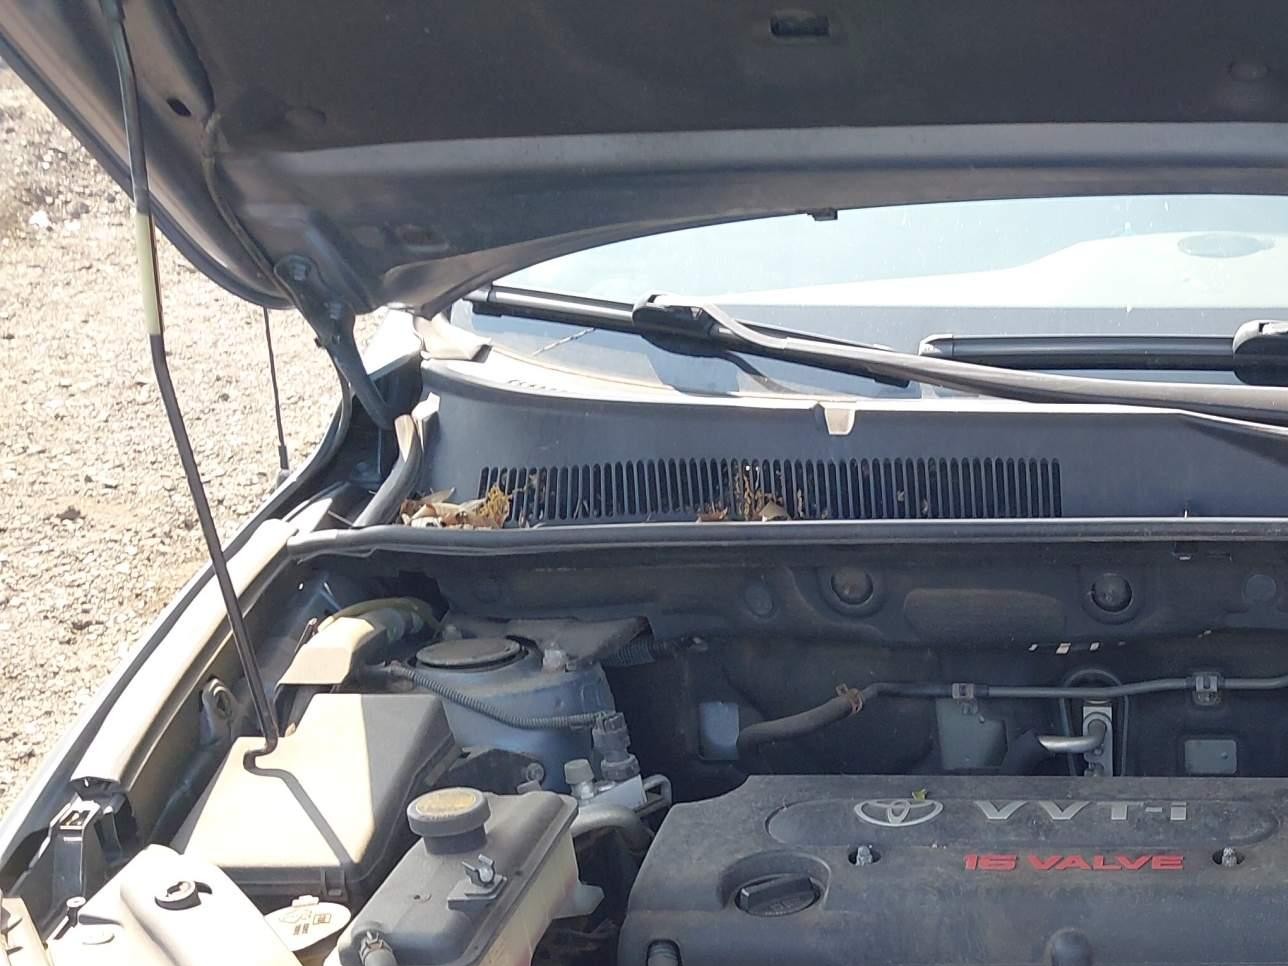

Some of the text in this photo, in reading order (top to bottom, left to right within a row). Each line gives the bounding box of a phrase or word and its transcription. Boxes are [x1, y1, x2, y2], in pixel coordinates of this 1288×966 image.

[973, 801, 1187, 821] VVT-i
[963, 854, 1185, 871] 16 VALVE
